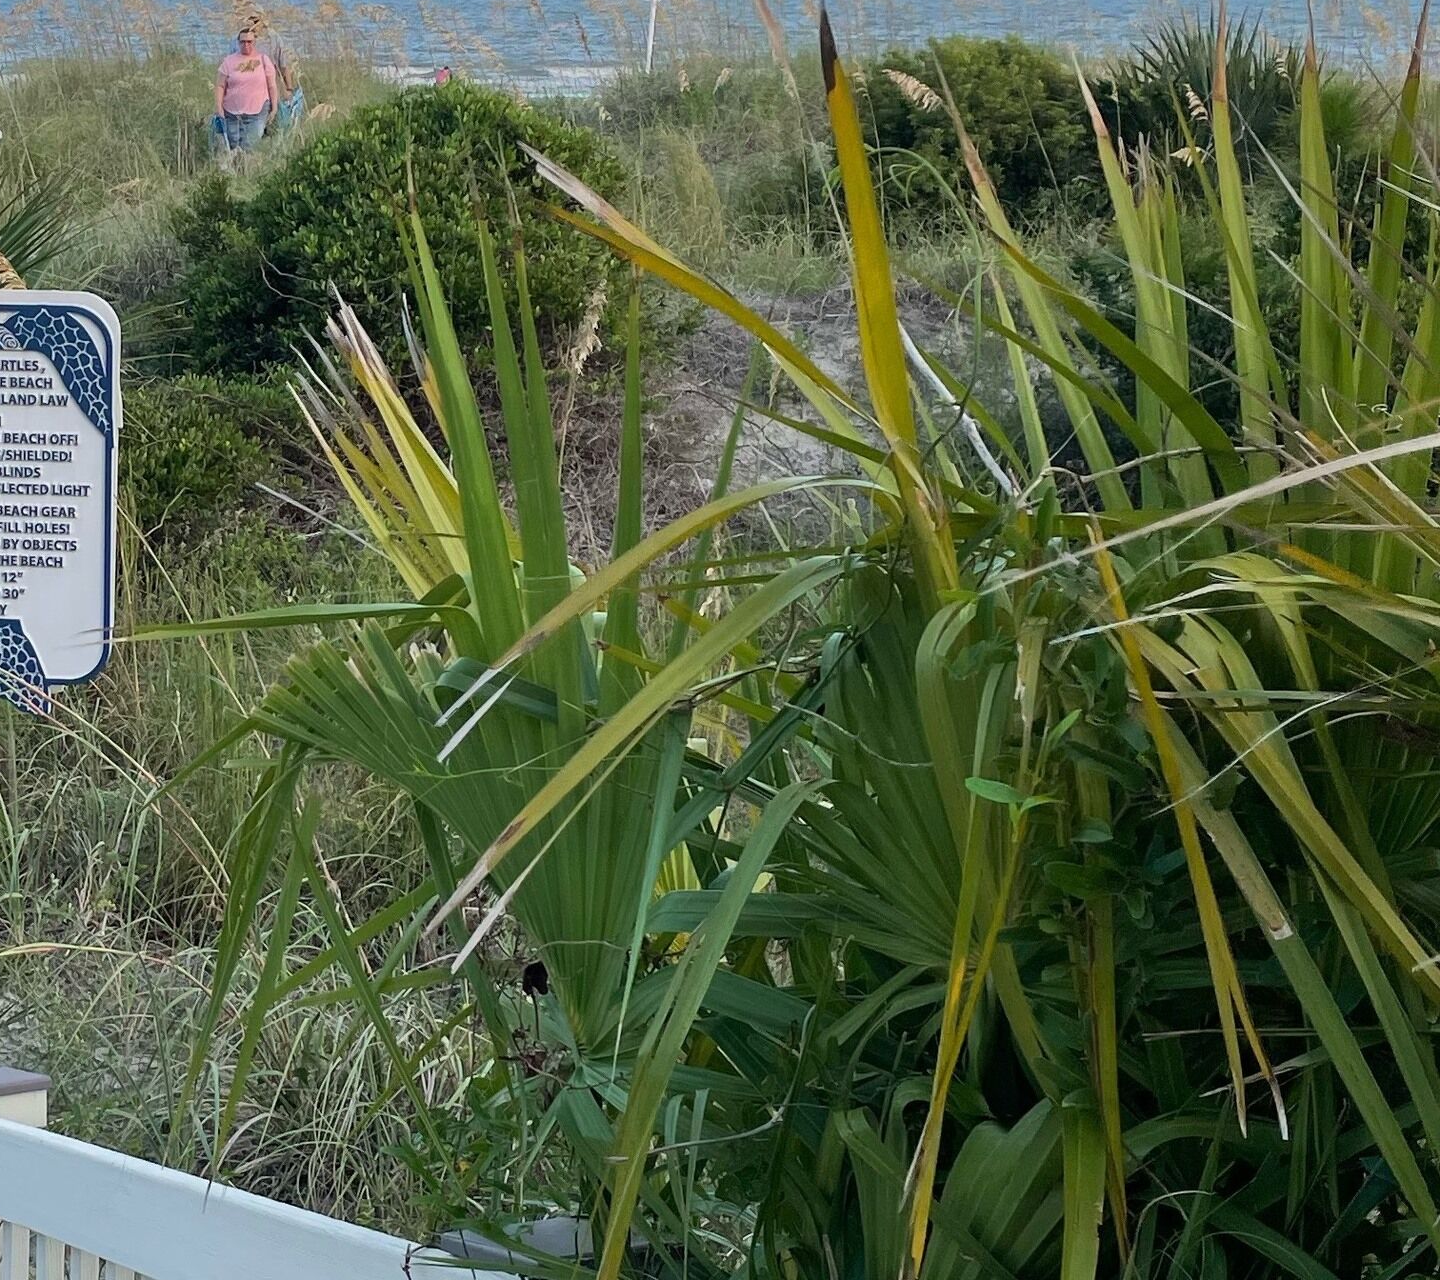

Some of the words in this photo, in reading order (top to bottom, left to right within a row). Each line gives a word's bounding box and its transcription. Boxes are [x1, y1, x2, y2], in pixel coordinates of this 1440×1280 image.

[9, 377, 52, 389] BEACH
[39, 395, 68, 407] LAW
[3, 432, 47, 444] BEACH
[49, 433, 78, 446] OFF!
[52, 484, 90, 497] LIGHT
[41, 506, 76, 518] GEAR
[25, 522, 70, 534] HOLES!
[2, 538, 19, 549] BY
[22, 539, 77, 551] OBJECTS
[19, 555, 62, 568] BEACH
